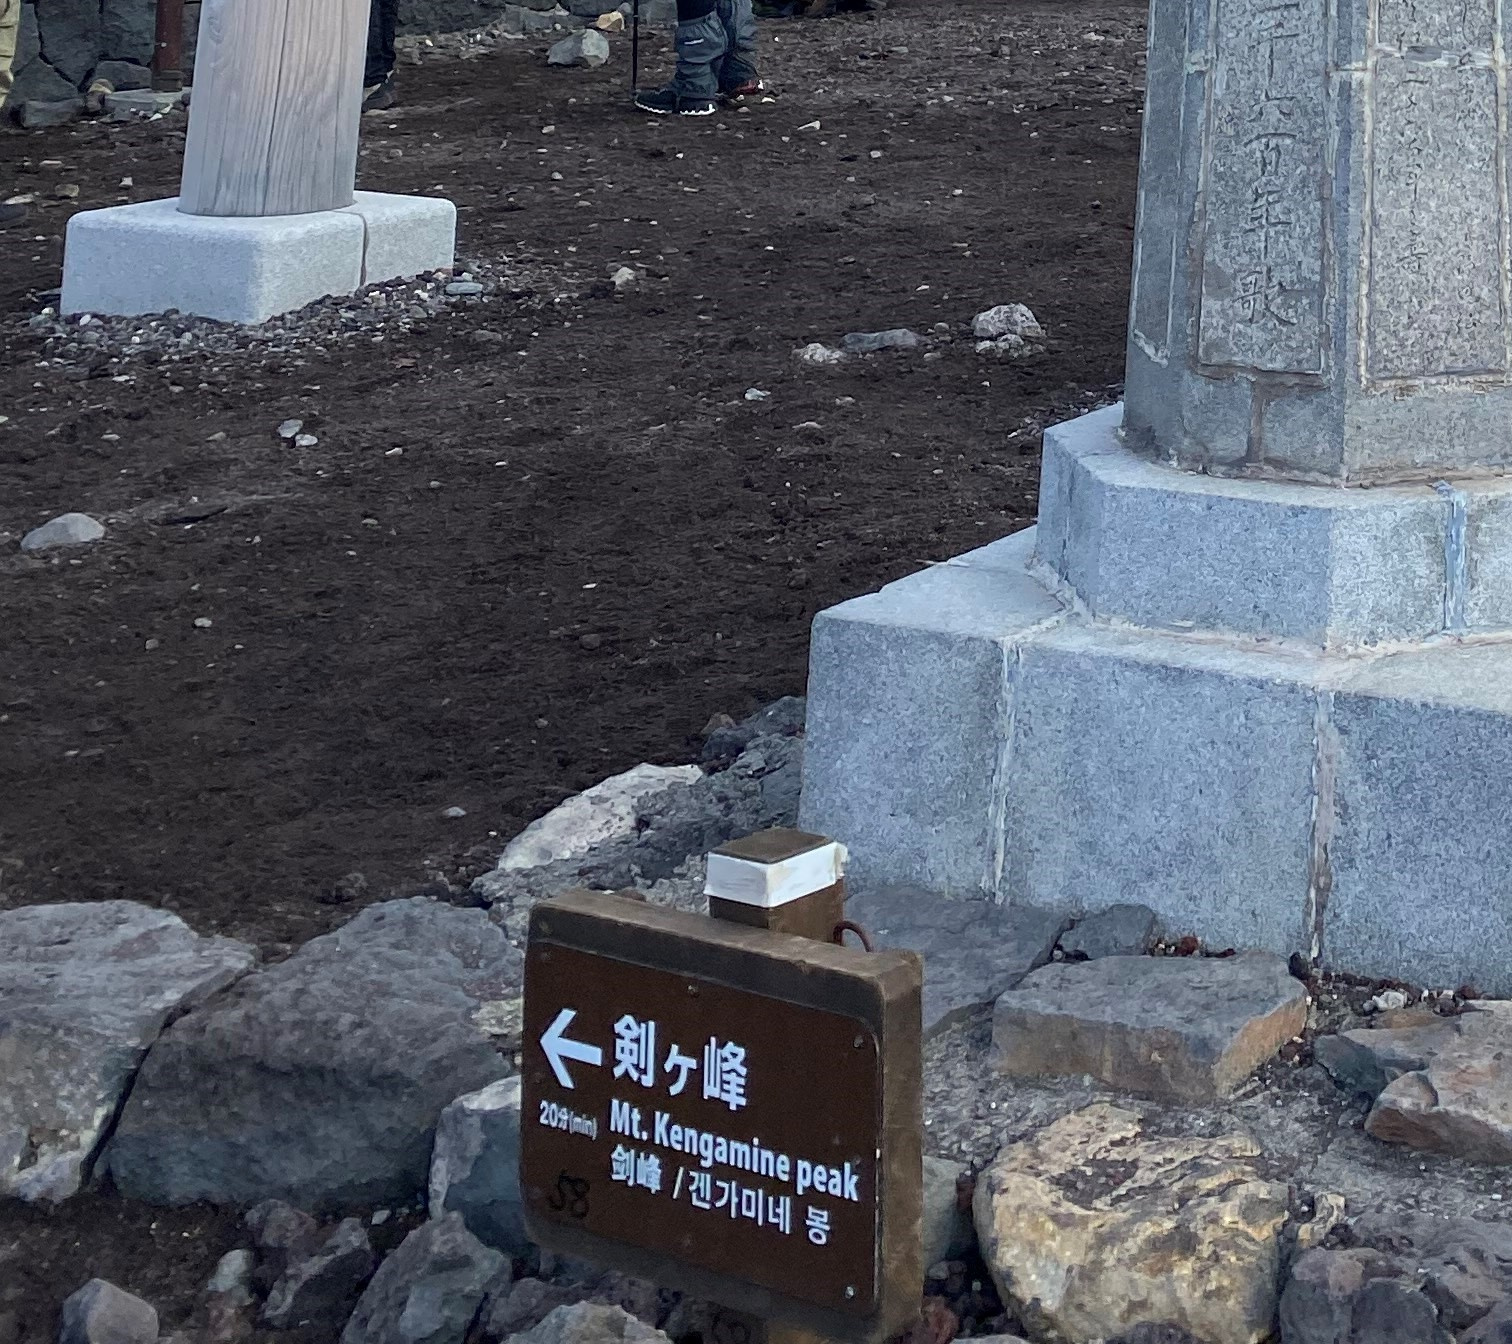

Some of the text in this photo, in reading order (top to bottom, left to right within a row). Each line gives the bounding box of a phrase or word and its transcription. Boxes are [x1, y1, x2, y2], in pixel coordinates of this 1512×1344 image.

[610, 1098, 859, 1201] Mt. Kengamine peak
